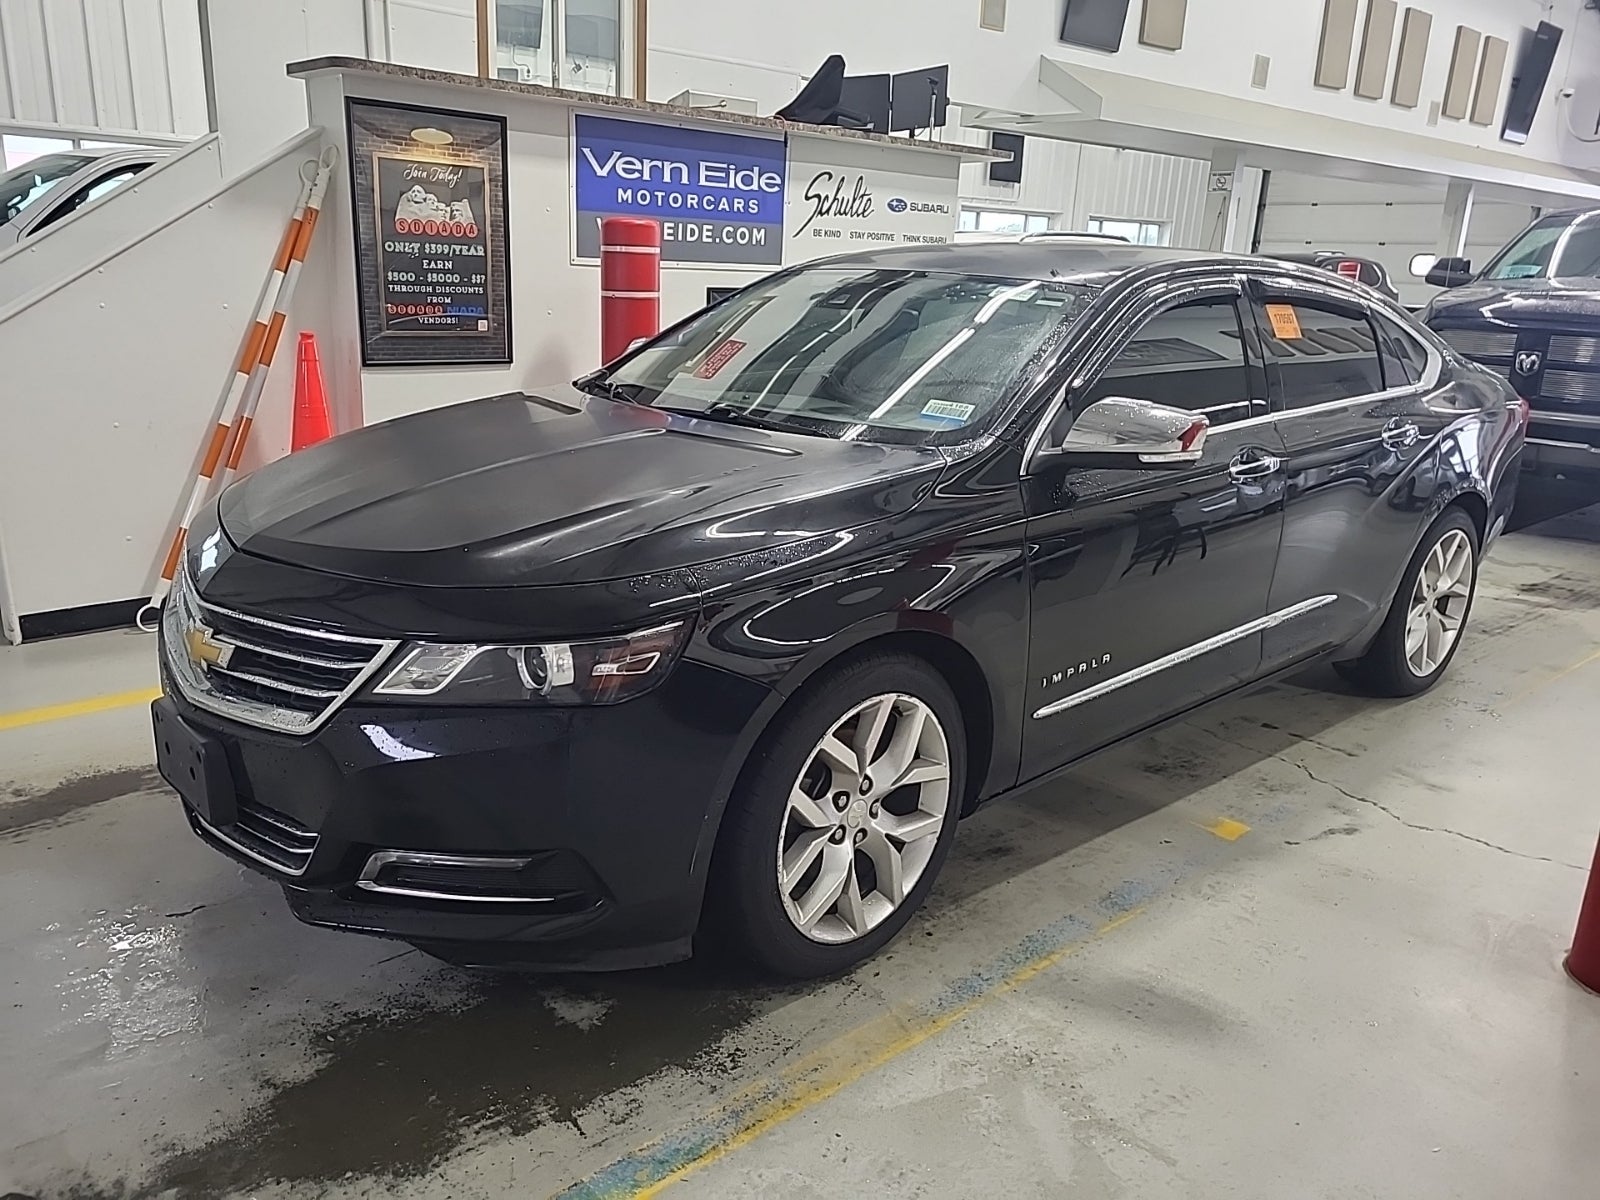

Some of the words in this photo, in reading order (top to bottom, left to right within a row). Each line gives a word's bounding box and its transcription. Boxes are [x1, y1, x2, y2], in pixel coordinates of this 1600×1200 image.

[403, 164, 427, 180] Join
[430, 166, 463, 188] Today!
[581, 147, 689, 185] Vern
[699, 161, 782, 193] Eide
[617, 188, 760, 214] MOTORCARS
[792, 171, 875, 238] Schulte
[909, 202, 949, 214] SUBARU
[395, 218, 478, 238] SDIADA
[813, 228, 823, 237] BE
[824, 229, 842, 239] KIND
[849, 231, 865, 240] STAY
[866, 232, 896, 242] POSITIVE
[902, 234, 921, 243] THINK
[385, 241, 420, 253] ONLY
[424, 243, 485, 257] $399/YEAR
[422, 260, 453, 269] EARN
[387, 271, 416, 282] $500
[426, 272, 460, 283] $5000
[388, 284, 433, 293] THROUGH
[435, 286, 484, 294] DISCOUNTS
[427, 296, 452, 304] FROM
[1042, 653, 1111, 688] IMPALA
